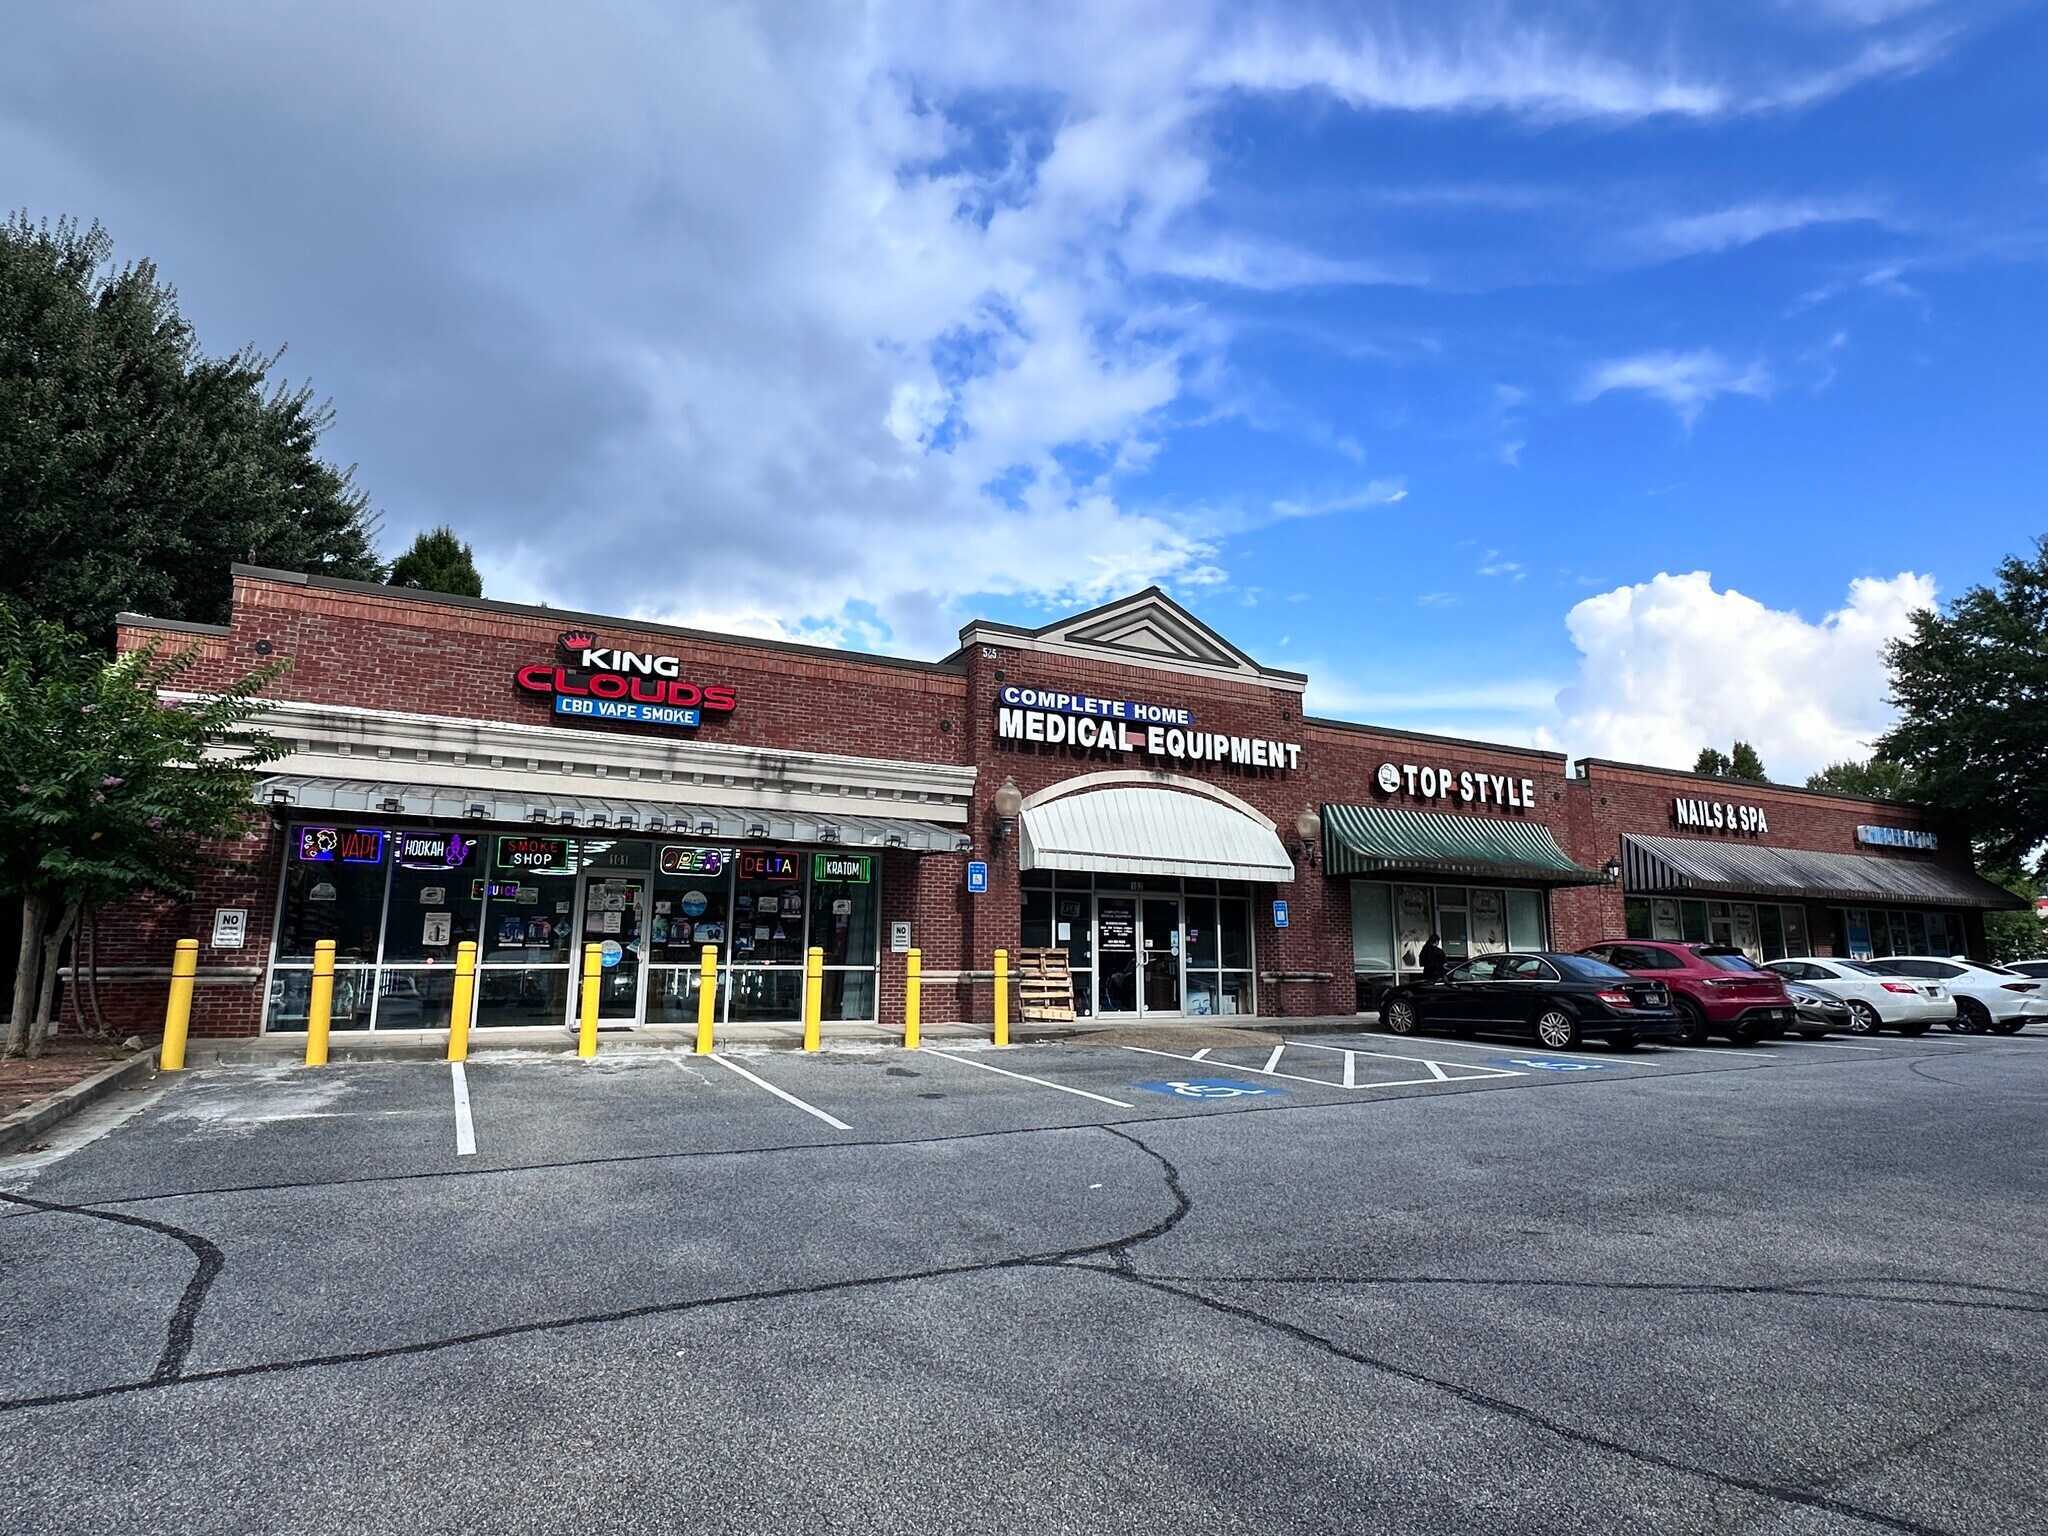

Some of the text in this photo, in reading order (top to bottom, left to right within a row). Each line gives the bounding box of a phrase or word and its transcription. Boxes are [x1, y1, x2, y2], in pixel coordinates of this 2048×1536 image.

[582, 649, 679, 677] KING
[517, 665, 736, 711] CLOUDS
[562, 699, 694, 724] CBD VAPE SMOKE
[1004, 687, 1190, 726] COMPLETE HOME
[999, 708, 1301, 770] MEDICAL EQUIPMENT
[1403, 764, 1535, 808] TOP STYLE
[1676, 798, 1768, 833] NAILS & SPA
[341, 832, 380, 859] VAPE
[405, 839, 444, 857] HOOKAH
[508, 841, 558, 853] SMOKE
[513, 853, 552, 865] SHOP
[610, 854, 628, 865] 101
[662, 850, 720, 872] OPEN
[745, 857, 792, 874] DELTA
[826, 861, 860, 875] KRATOM
[222, 915, 239, 925] NO
[896, 927, 907, 935] NO
